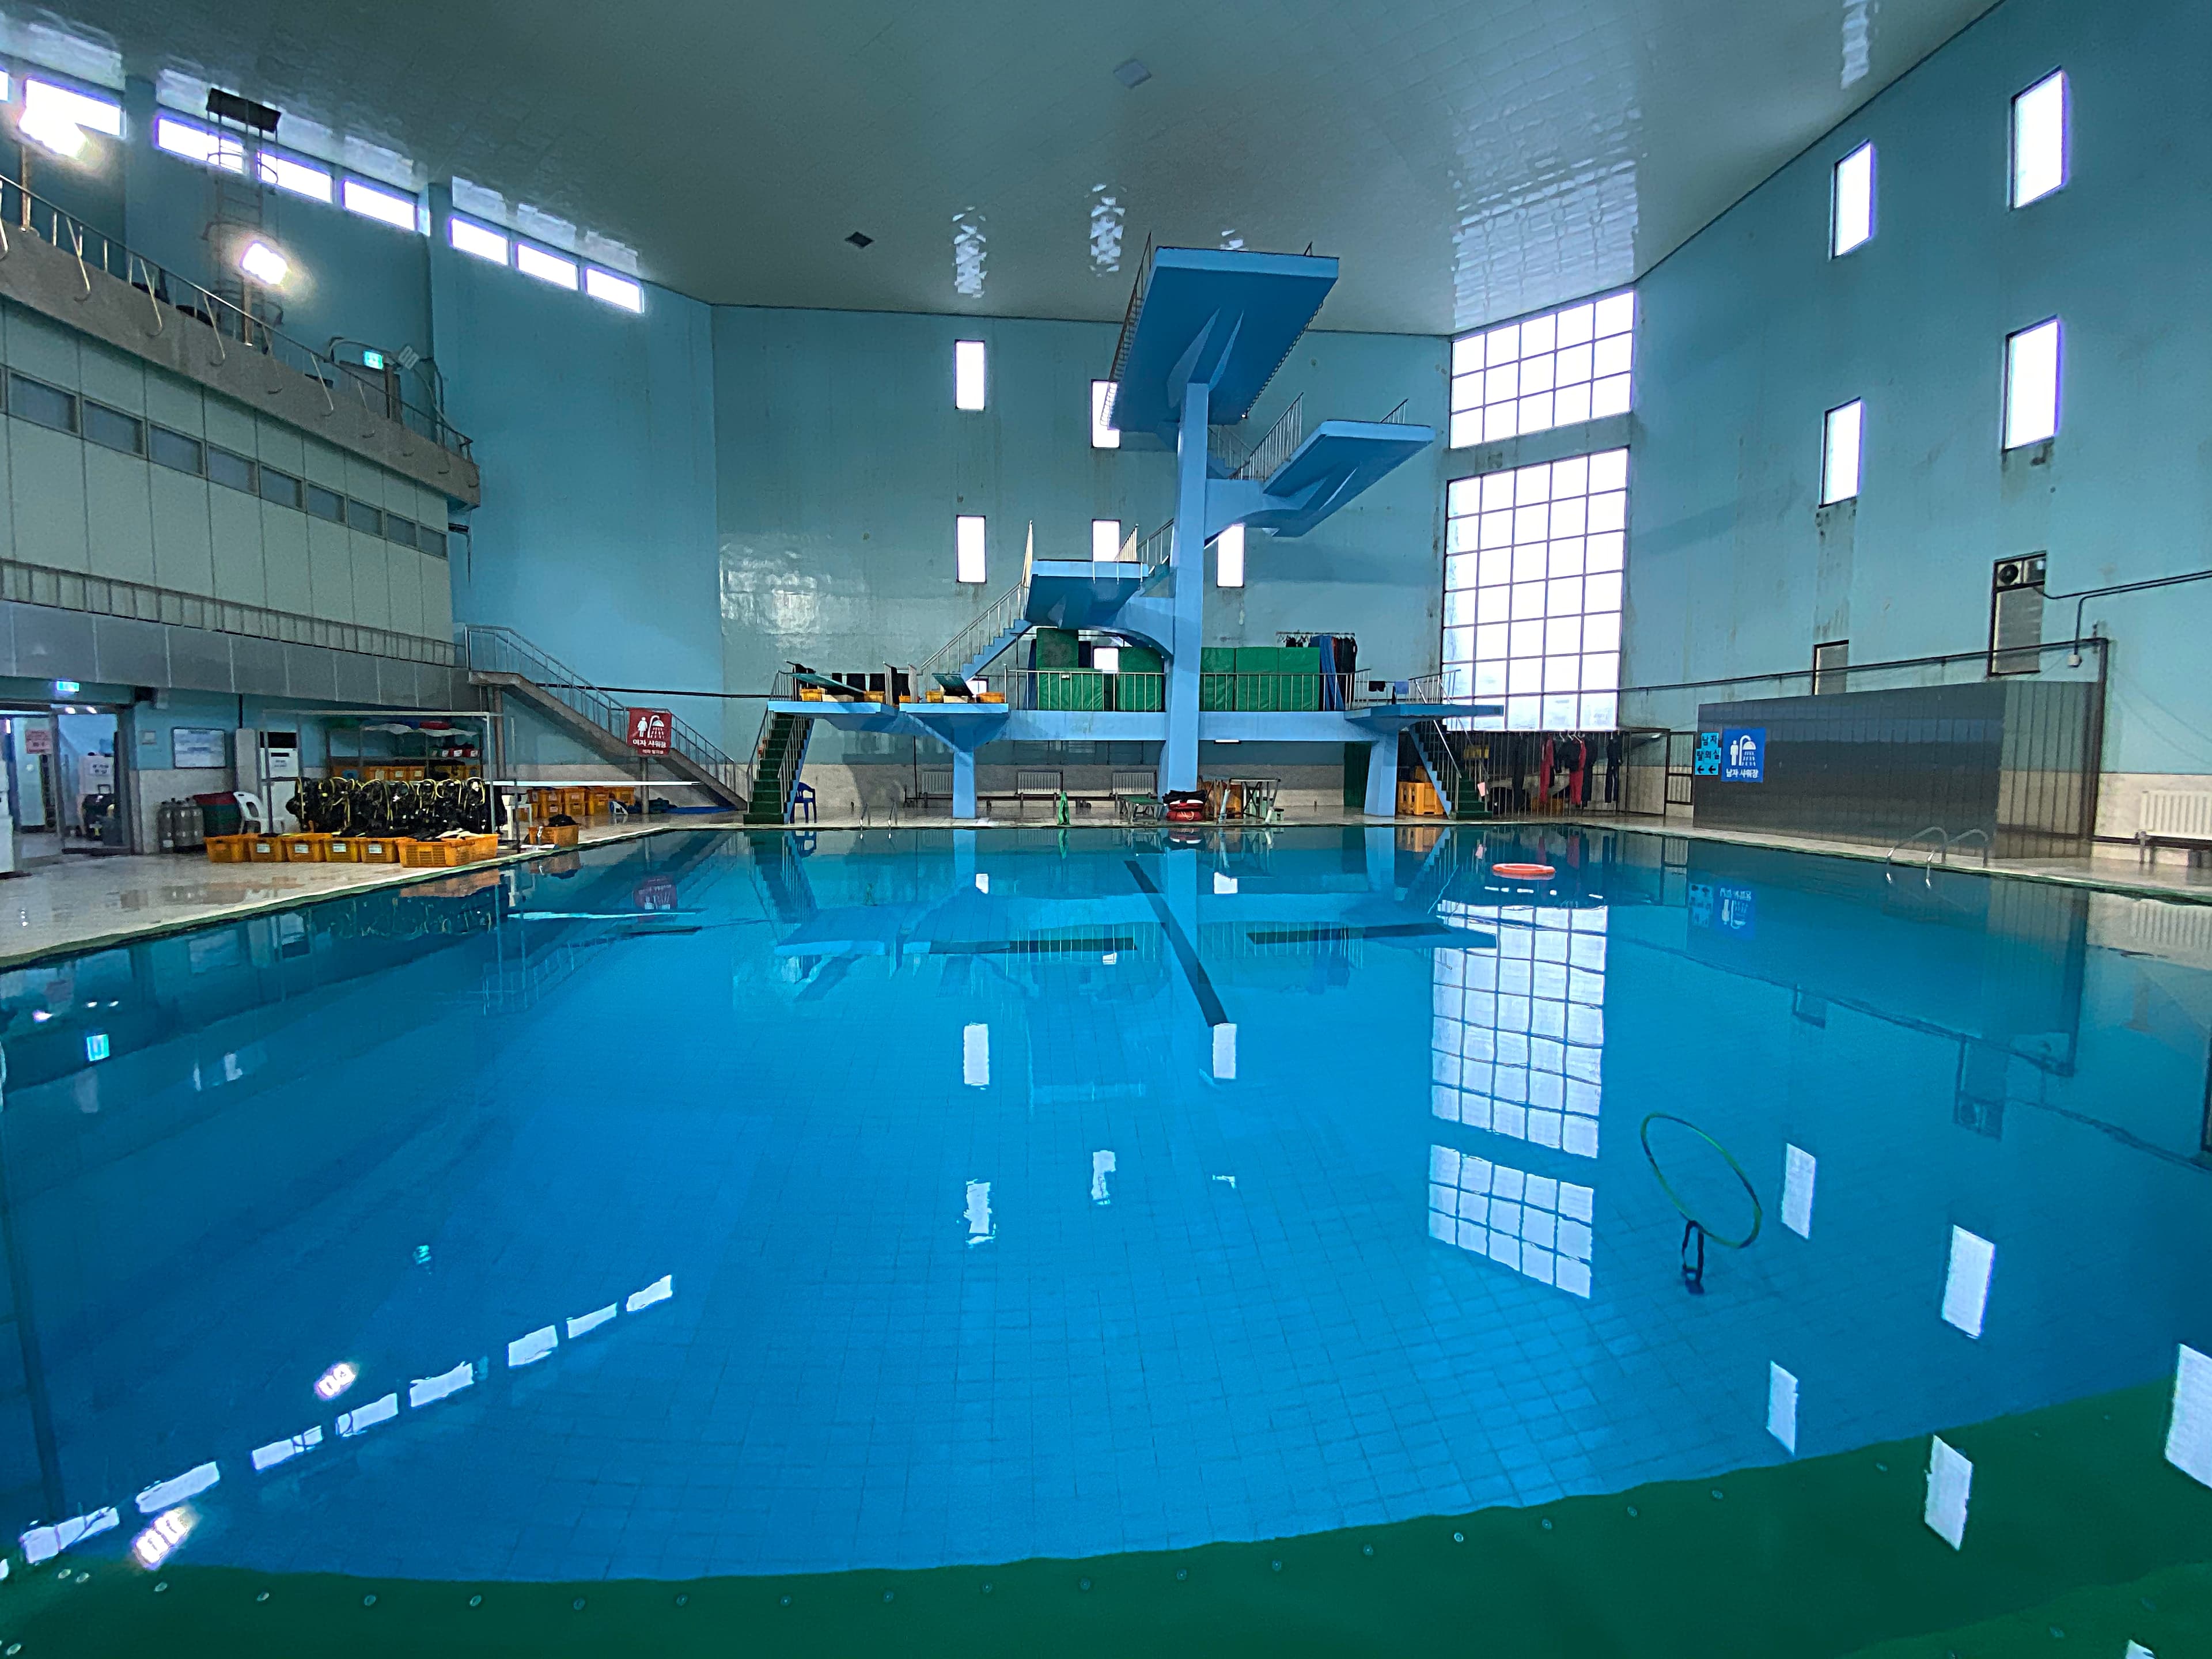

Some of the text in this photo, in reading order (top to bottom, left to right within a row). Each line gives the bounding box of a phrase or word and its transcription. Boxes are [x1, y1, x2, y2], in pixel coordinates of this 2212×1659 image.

[1702, 736, 1717, 746] 남자
[1696, 749, 1719, 761] 탈의실
[1726, 768, 1738, 778] 남자
